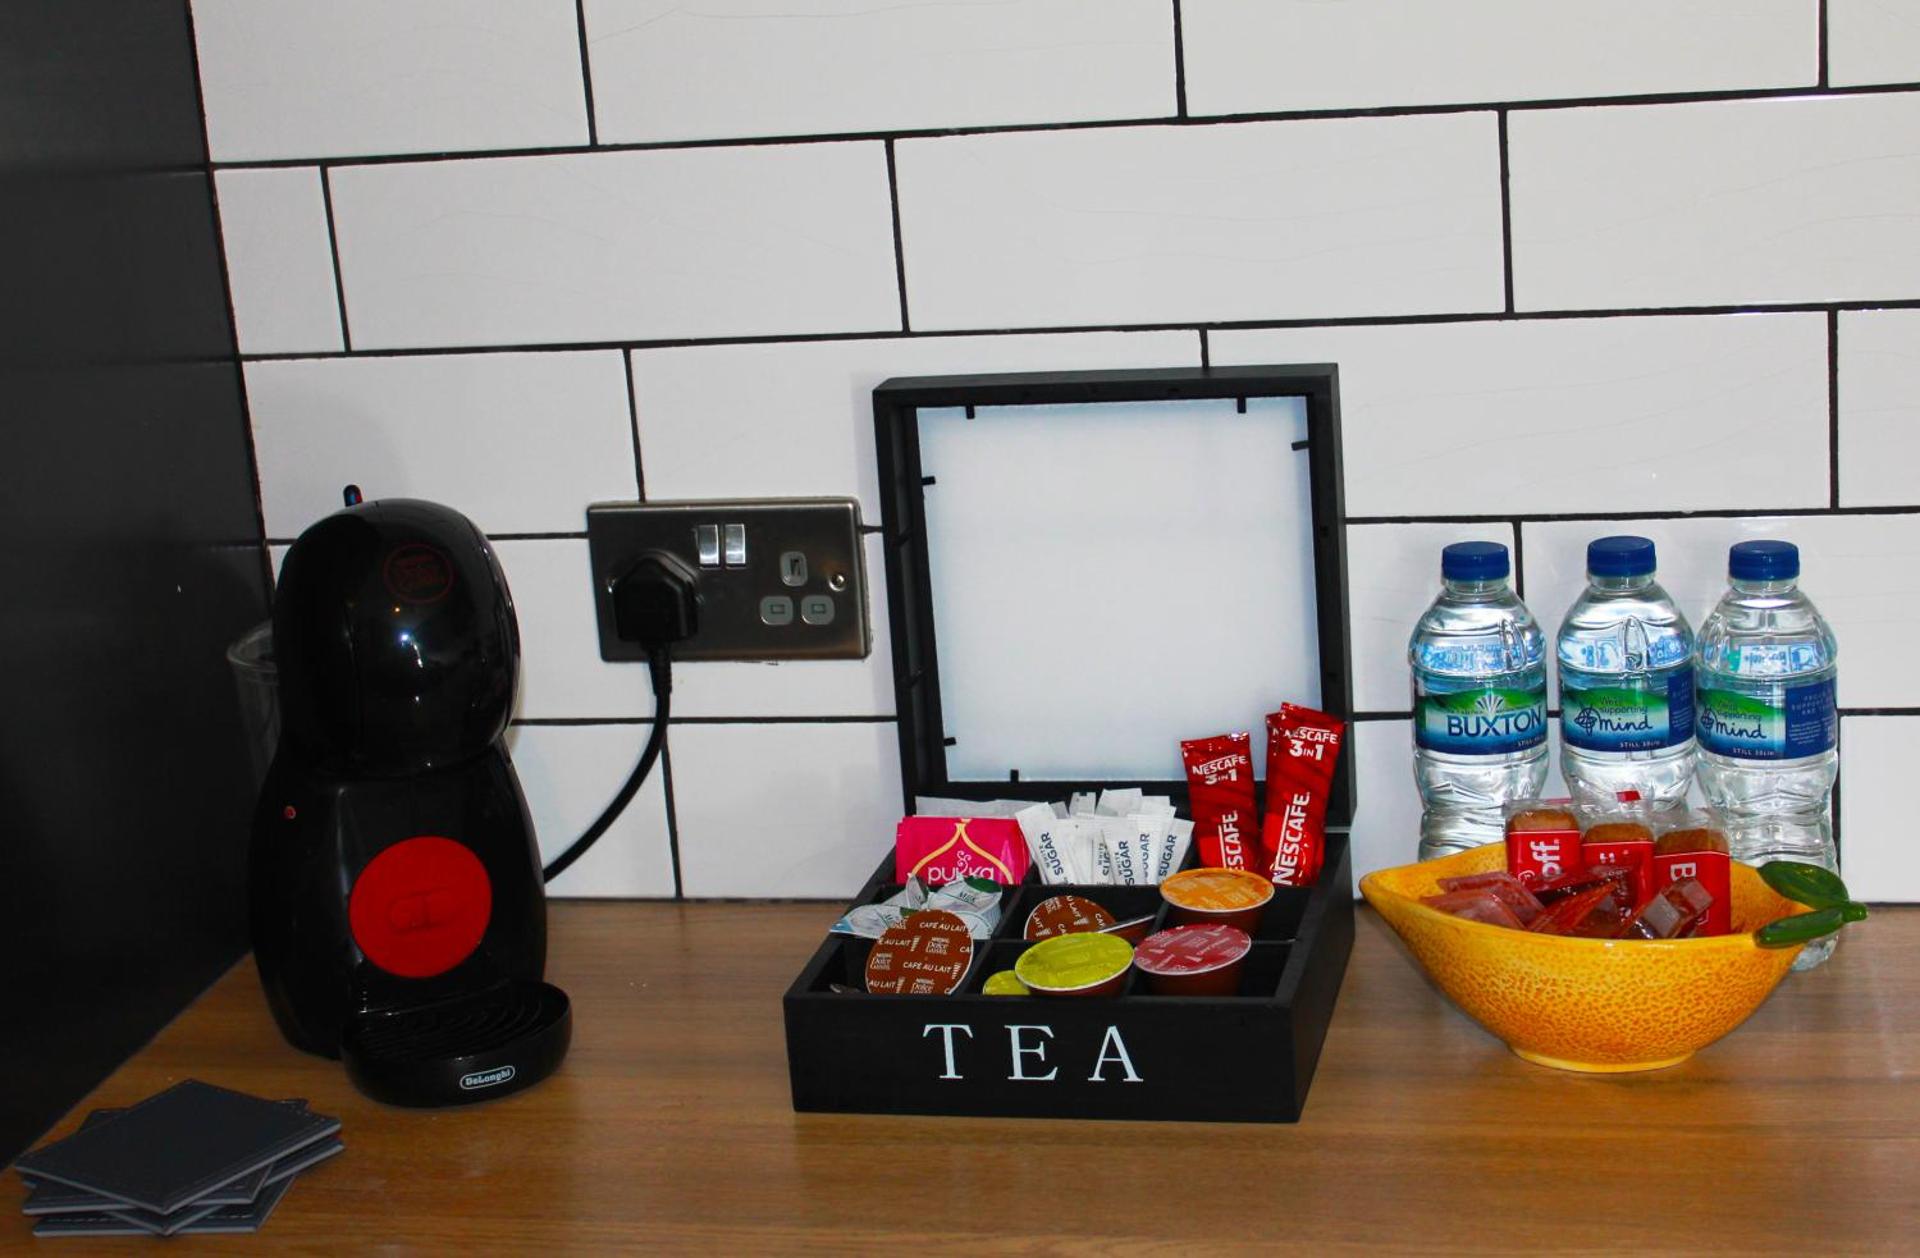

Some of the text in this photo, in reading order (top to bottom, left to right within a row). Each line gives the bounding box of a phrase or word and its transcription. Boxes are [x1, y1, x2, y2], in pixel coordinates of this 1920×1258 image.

[1446, 708, 1541, 737] BUXTON
[1599, 716, 1653, 731] mind
[1716, 722, 1767, 739] mind
[928, 851, 995, 884] pukka
[1041, 831, 1064, 876] SUGAR
[1118, 840, 1135, 885] SUGAR
[1158, 834, 1178, 876] SUGAR
[938, 923, 951, 931] AU
[951, 924, 966, 932] LAIT
[935, 966, 952, 974] LAIT
[880, 981, 897, 989] LAIT
[922, 1024, 1144, 1082] TEA
